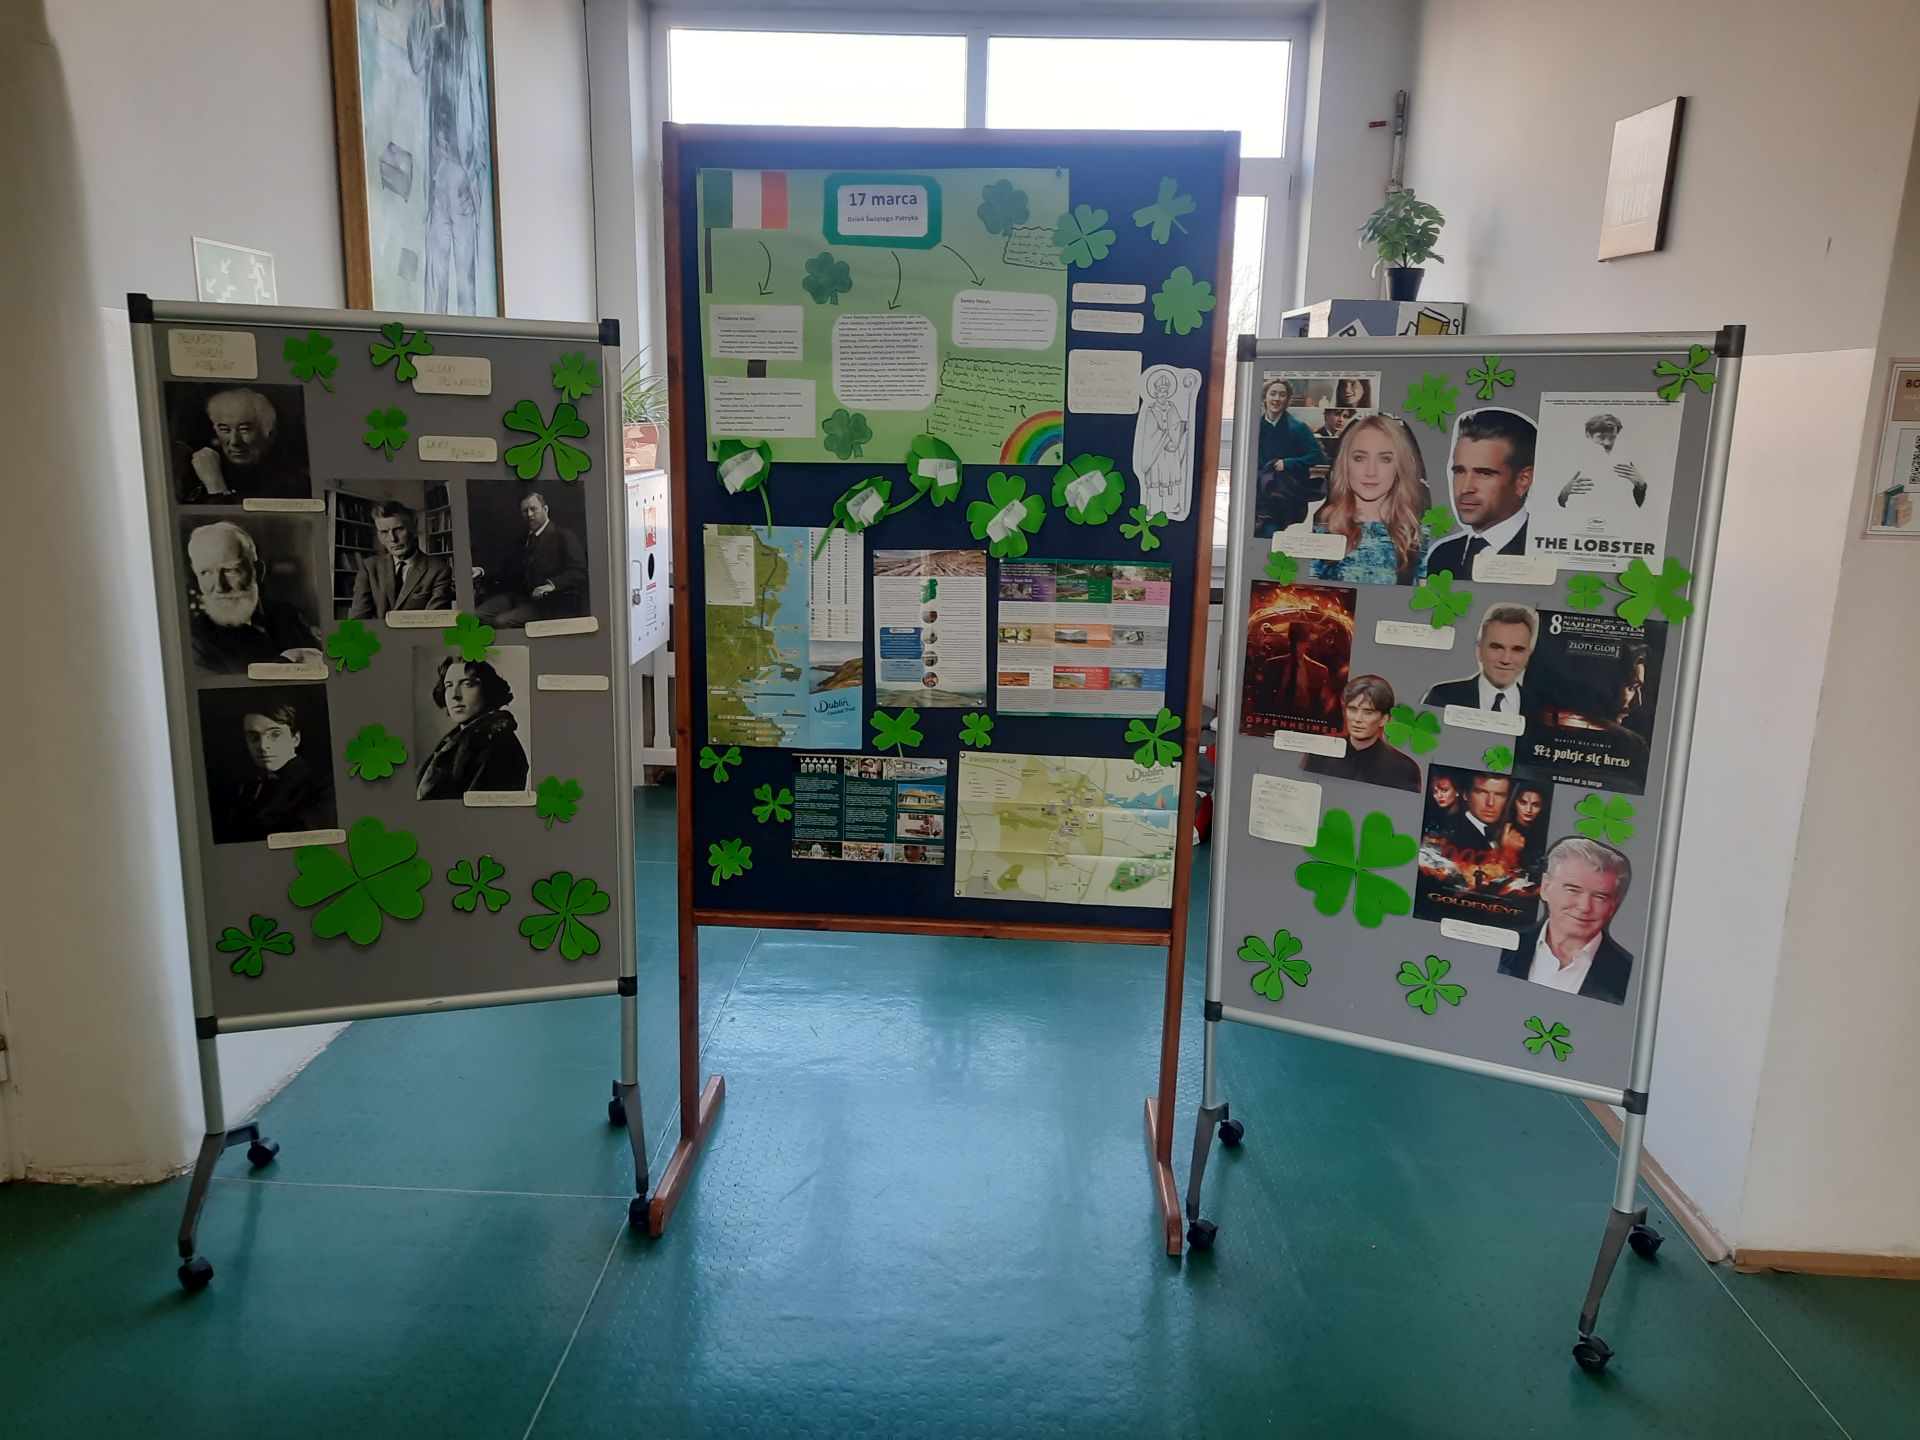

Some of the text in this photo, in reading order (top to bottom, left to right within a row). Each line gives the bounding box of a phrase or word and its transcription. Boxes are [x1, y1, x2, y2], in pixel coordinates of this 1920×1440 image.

[849, 192, 917, 207] 17 marca
[847, 214, 918, 224] Dzień Świętego Patryka
[1534, 536, 1655, 556] THE LOBSTER
[1549, 614, 1563, 635] 8
[1562, 620, 1619, 631] NAJLEPSZY
[1568, 641, 1616, 653] ZŁOTY GLOB
[814, 697, 850, 713] Dublin
[1246, 716, 1338, 737] OPPENHEIMER
[1552, 748, 1585, 764] poleje
[1585, 752, 1602, 767] się
[1604, 753, 1631, 768] krew
